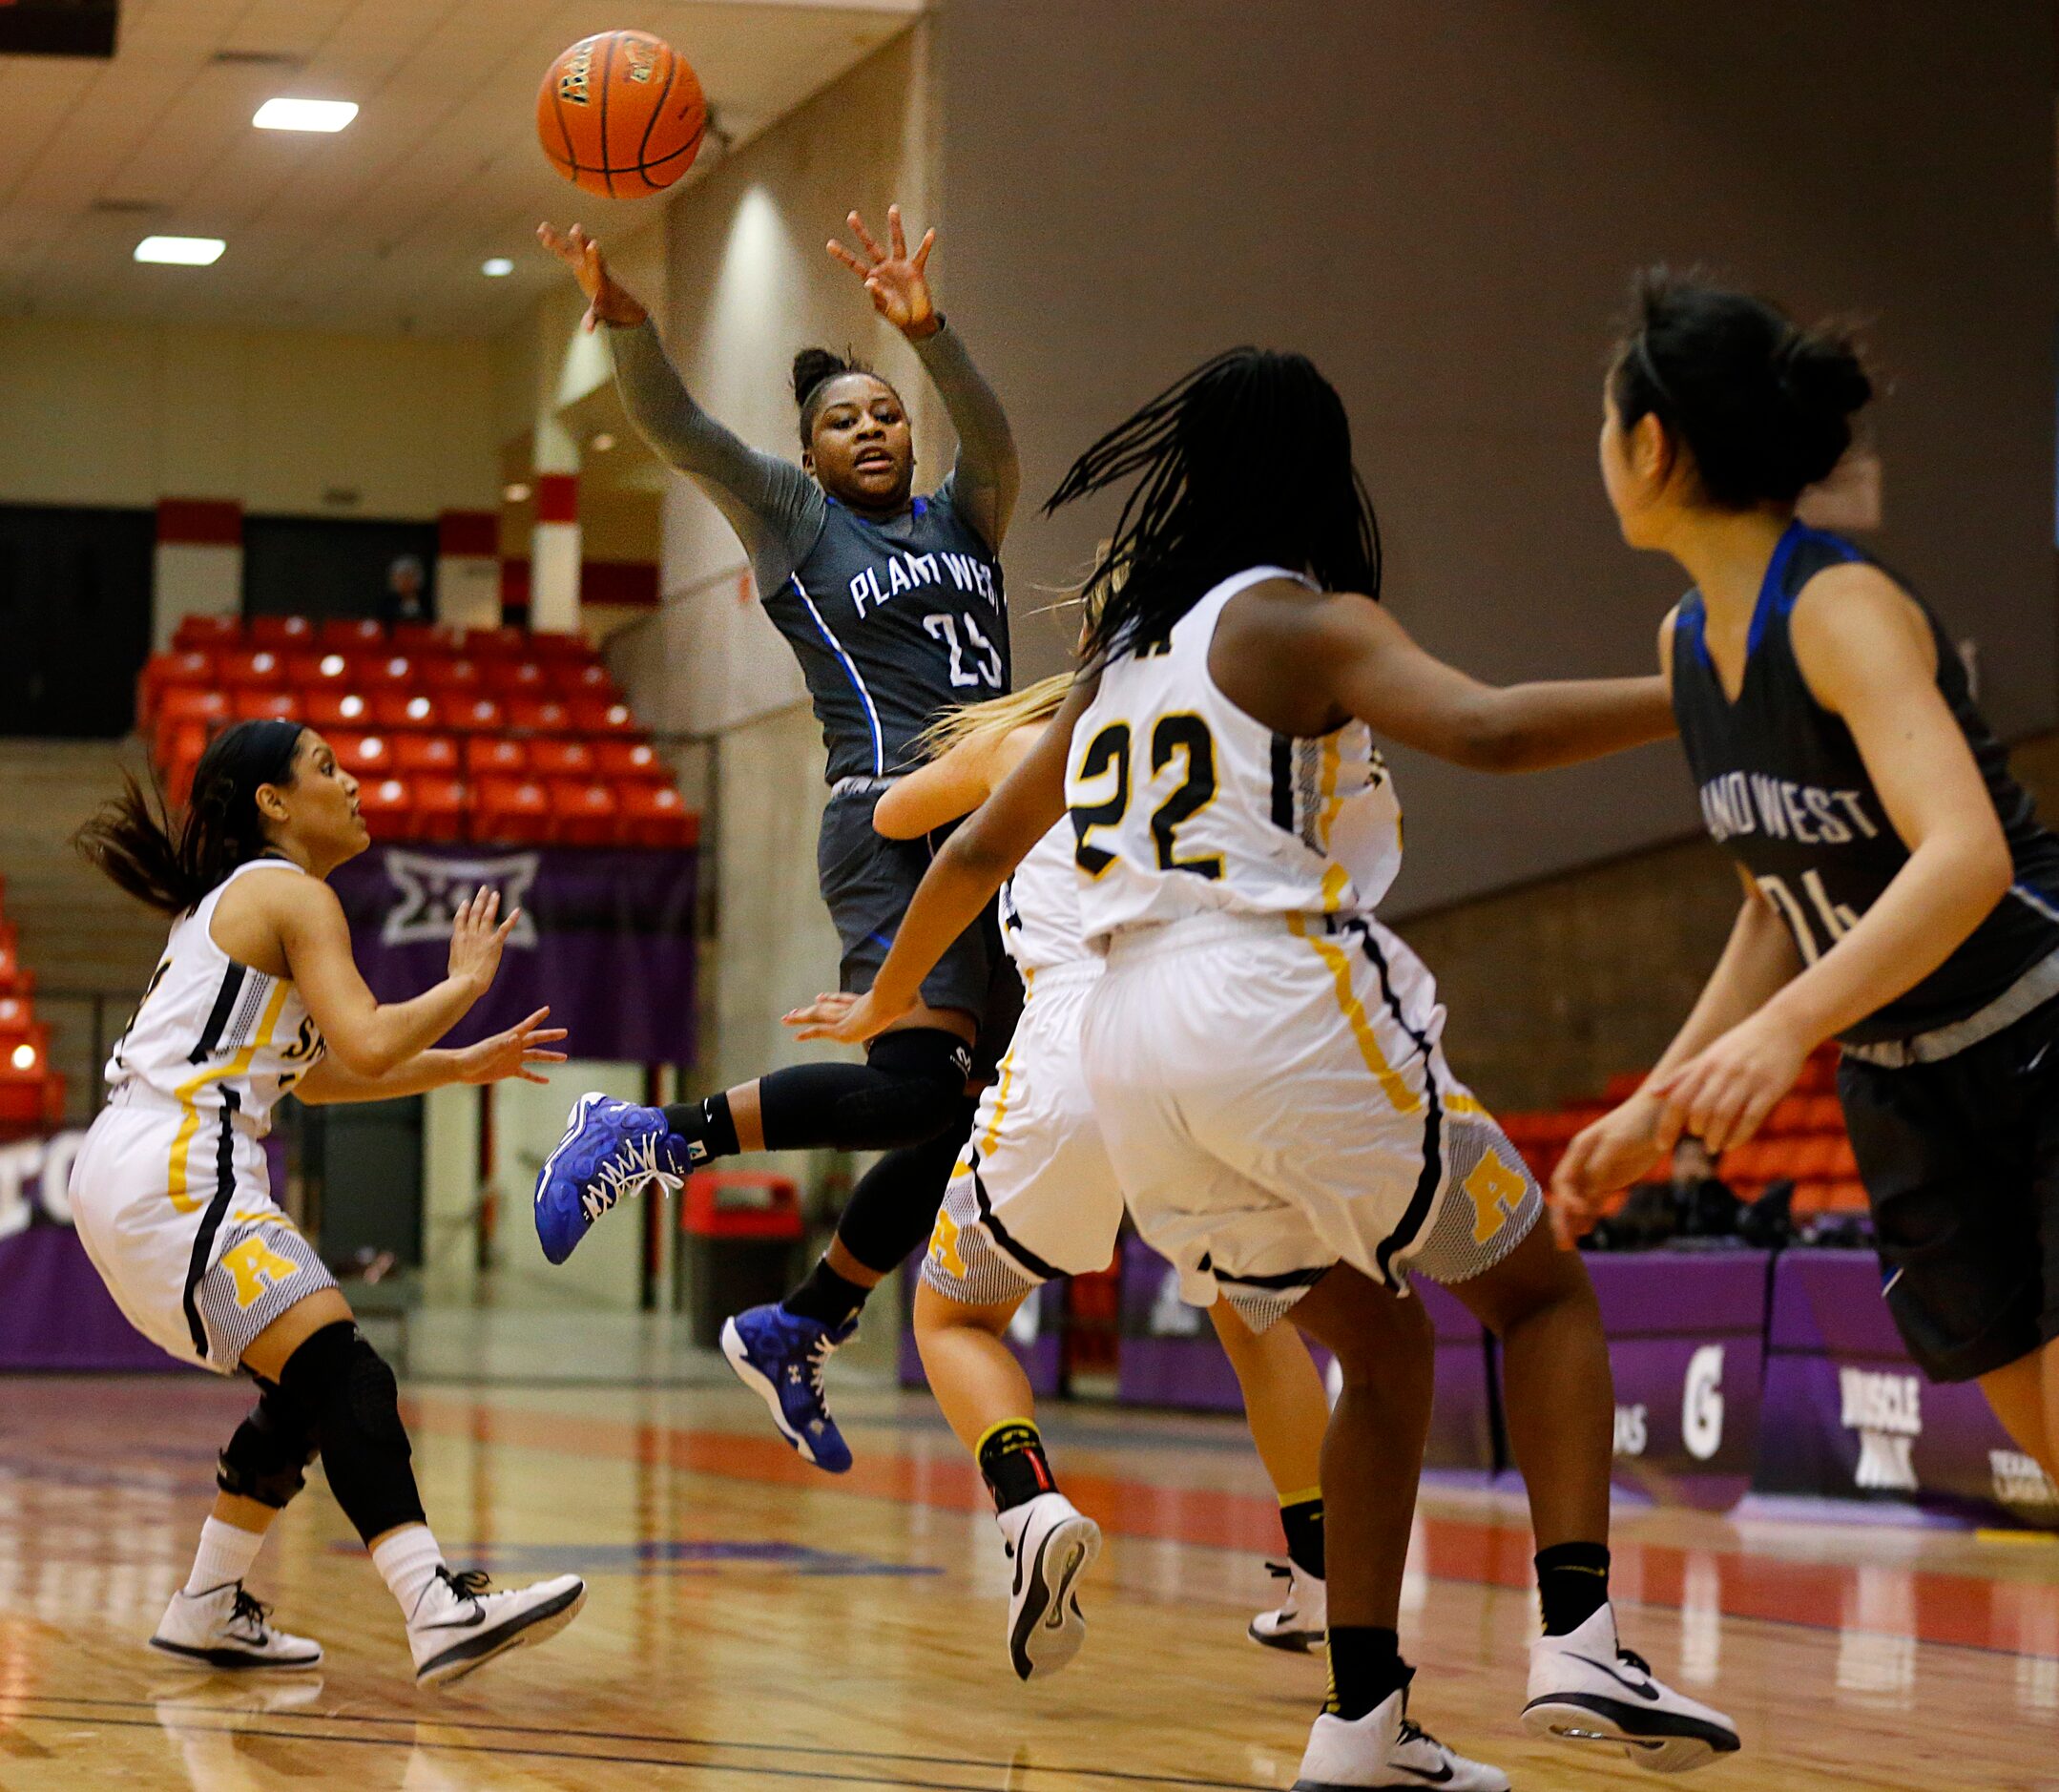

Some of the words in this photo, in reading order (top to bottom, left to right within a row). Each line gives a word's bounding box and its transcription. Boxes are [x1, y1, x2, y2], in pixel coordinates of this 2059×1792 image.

[923, 612, 1002, 689] 25
[1068, 709, 1225, 880] 22
[1749, 771, 1879, 844] WEST
[1464, 1145, 1528, 1245] A
[220, 1234, 301, 1310] A
[928, 1208, 967, 1280] A
